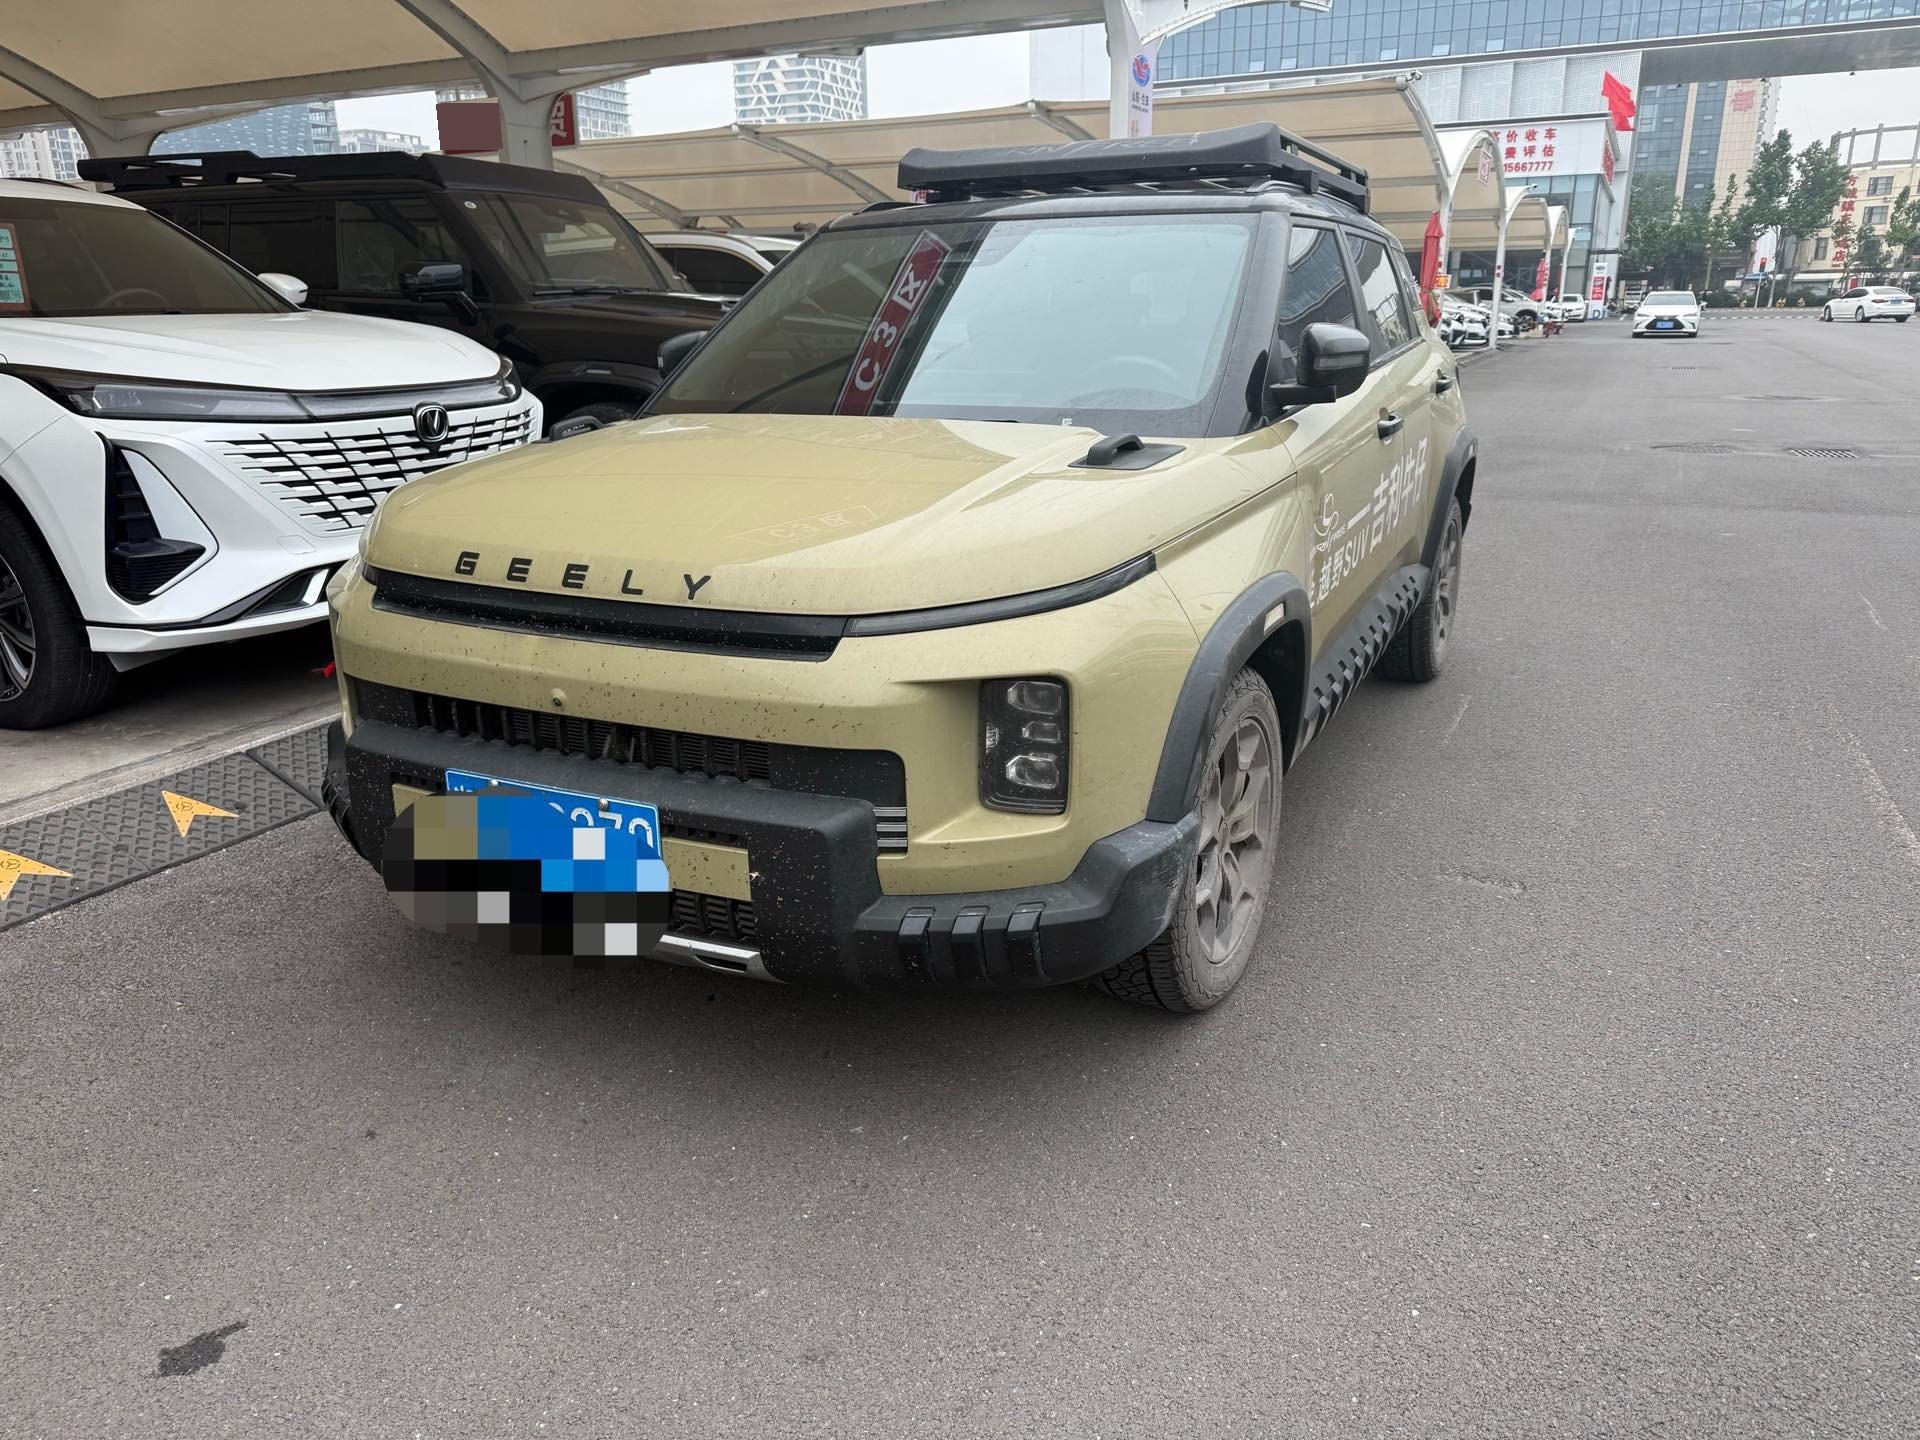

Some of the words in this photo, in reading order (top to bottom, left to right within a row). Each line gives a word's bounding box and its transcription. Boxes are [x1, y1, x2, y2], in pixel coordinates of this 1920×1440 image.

[1370, 437, 1428, 554] 吉利牛仔
[455, 551, 712, 600] GEELY
